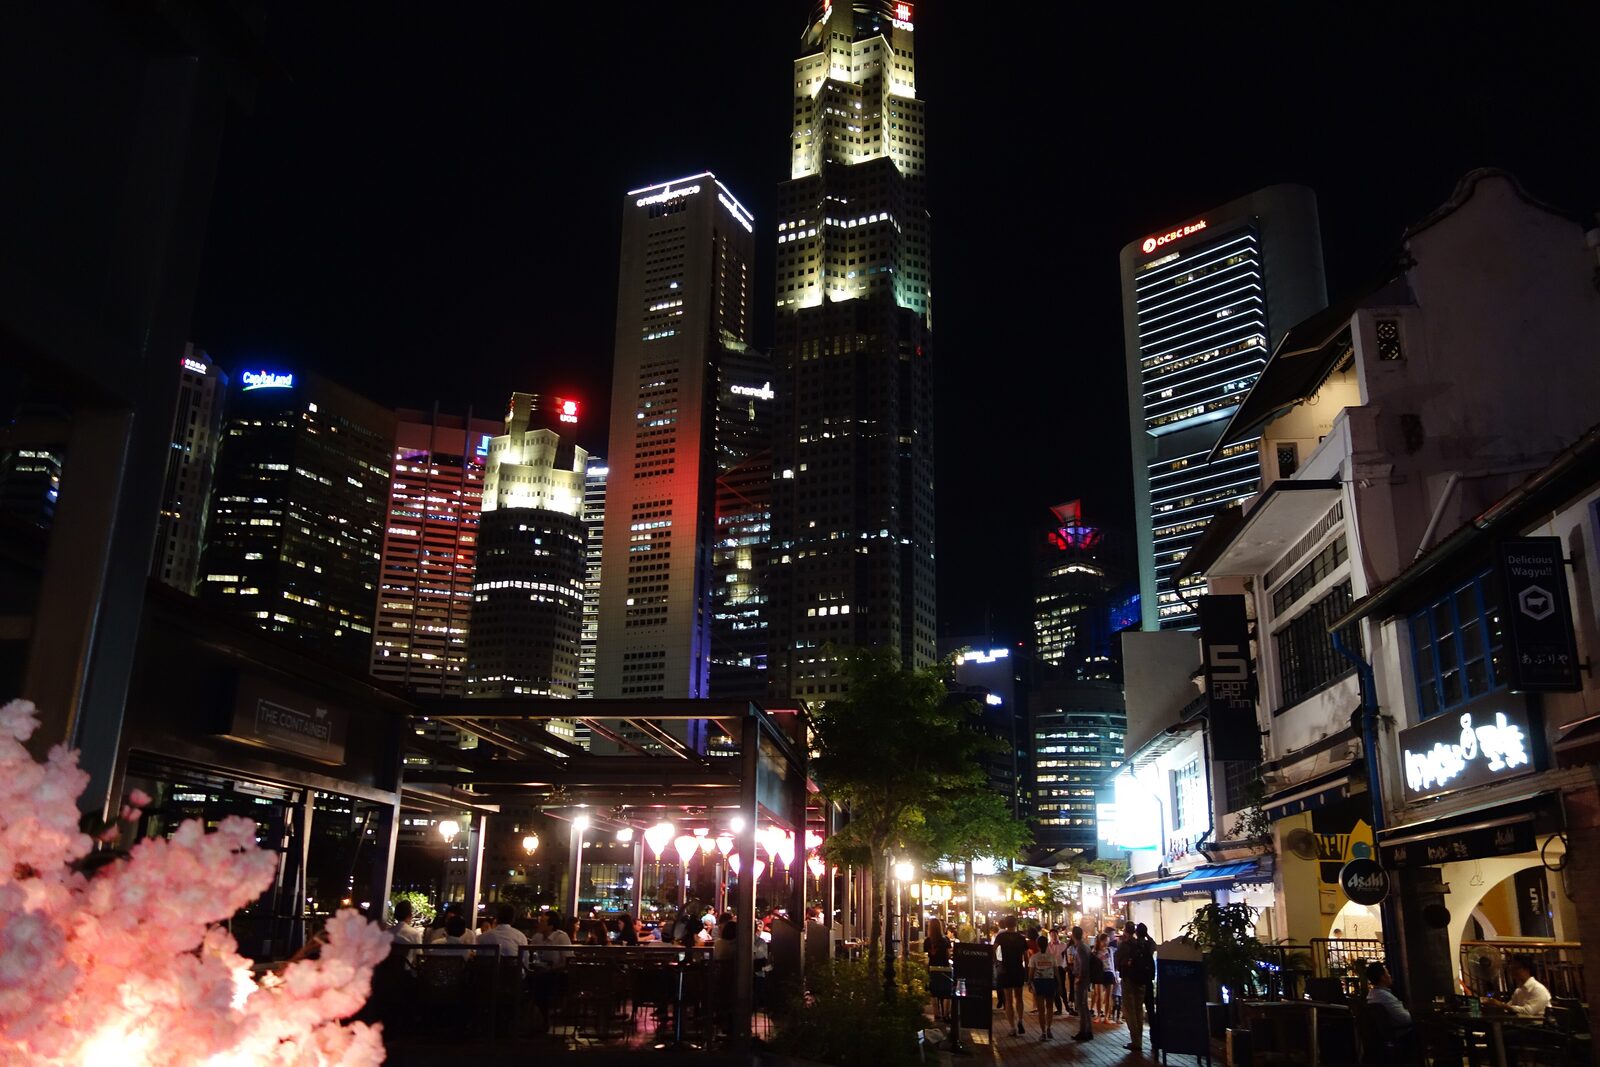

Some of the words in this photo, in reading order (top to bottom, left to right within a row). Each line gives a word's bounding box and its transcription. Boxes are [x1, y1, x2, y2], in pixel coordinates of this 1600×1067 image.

[1157, 229, 1183, 245] OCBC
[1183, 220, 1207, 235] Bank
[1508, 555, 1553, 566] Delicious
[1209, 644, 1249, 681] 5
[260, 706, 279, 725] THE
[280, 713, 328, 740] CONTAINER
